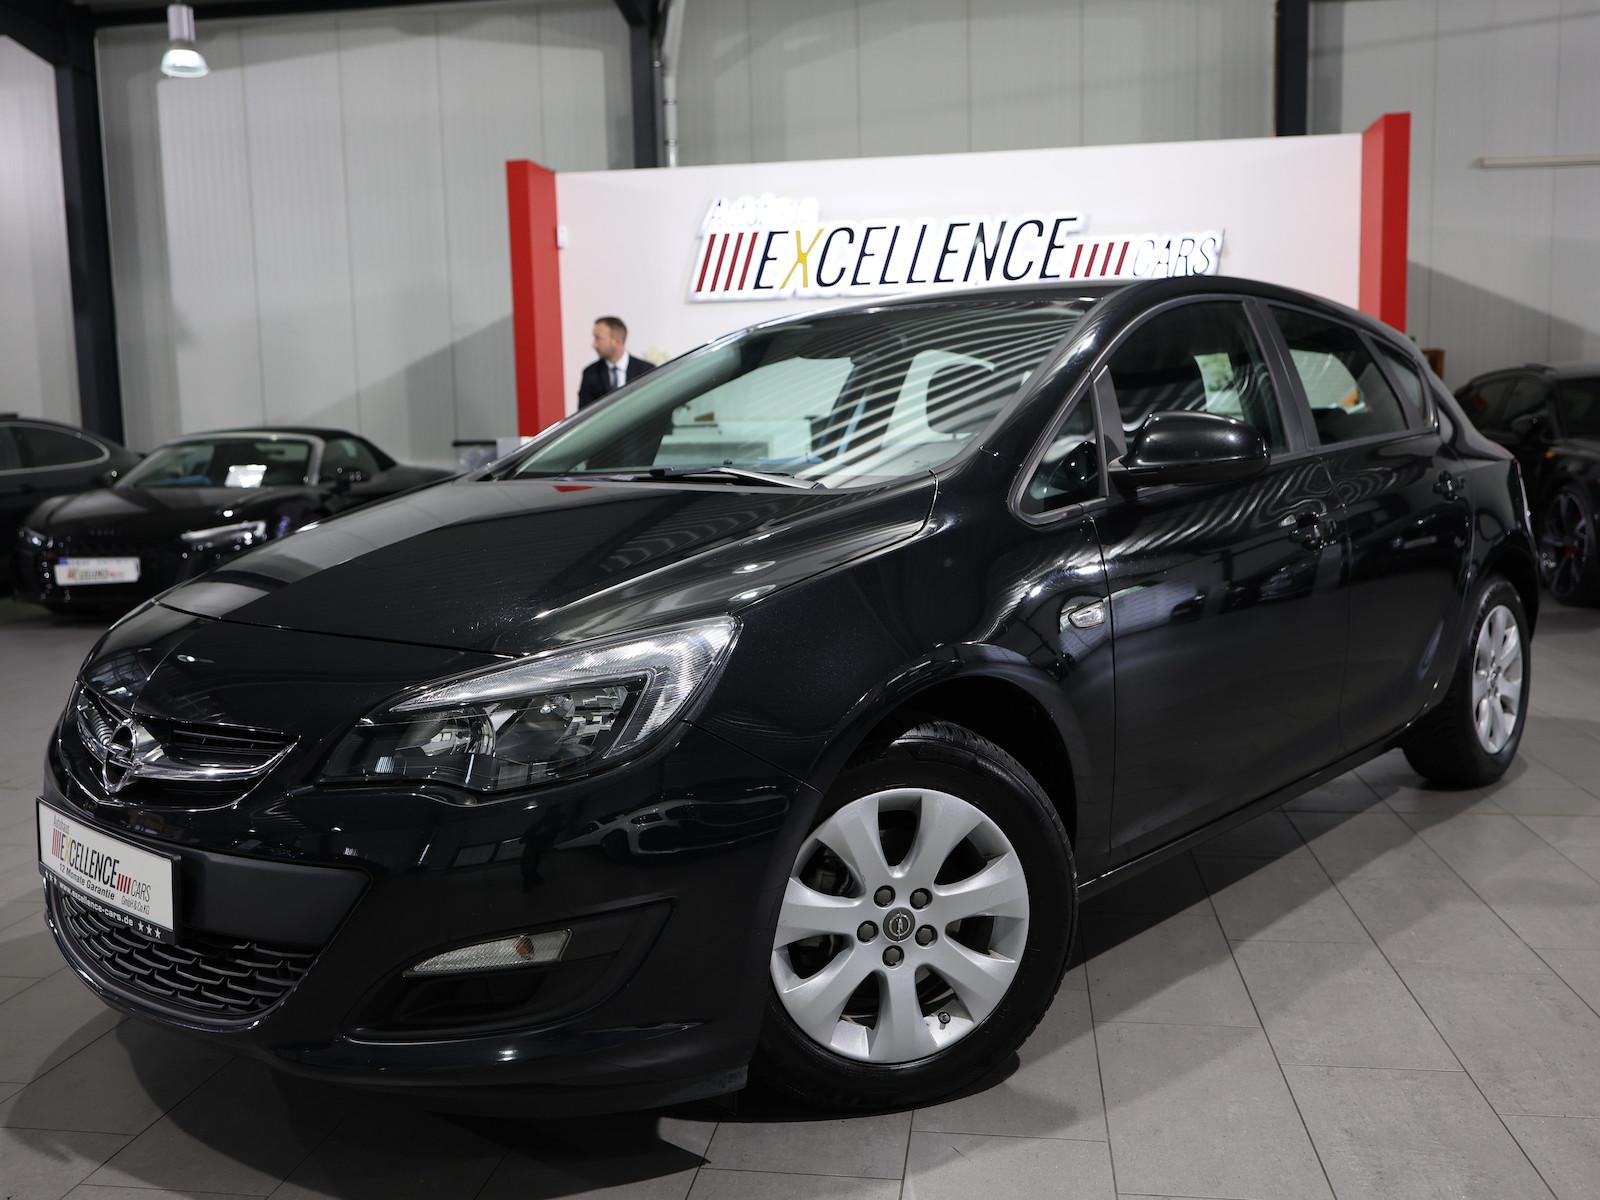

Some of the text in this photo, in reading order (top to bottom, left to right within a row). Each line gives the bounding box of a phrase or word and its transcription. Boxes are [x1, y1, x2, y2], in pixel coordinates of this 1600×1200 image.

[754, 216, 1217, 290] EXCELLENCE CARS
[59, 863, 66, 873] 12
[86, 879, 115, 900] Garantie
[60, 832, 151, 902] EXCELLENCE CARS
